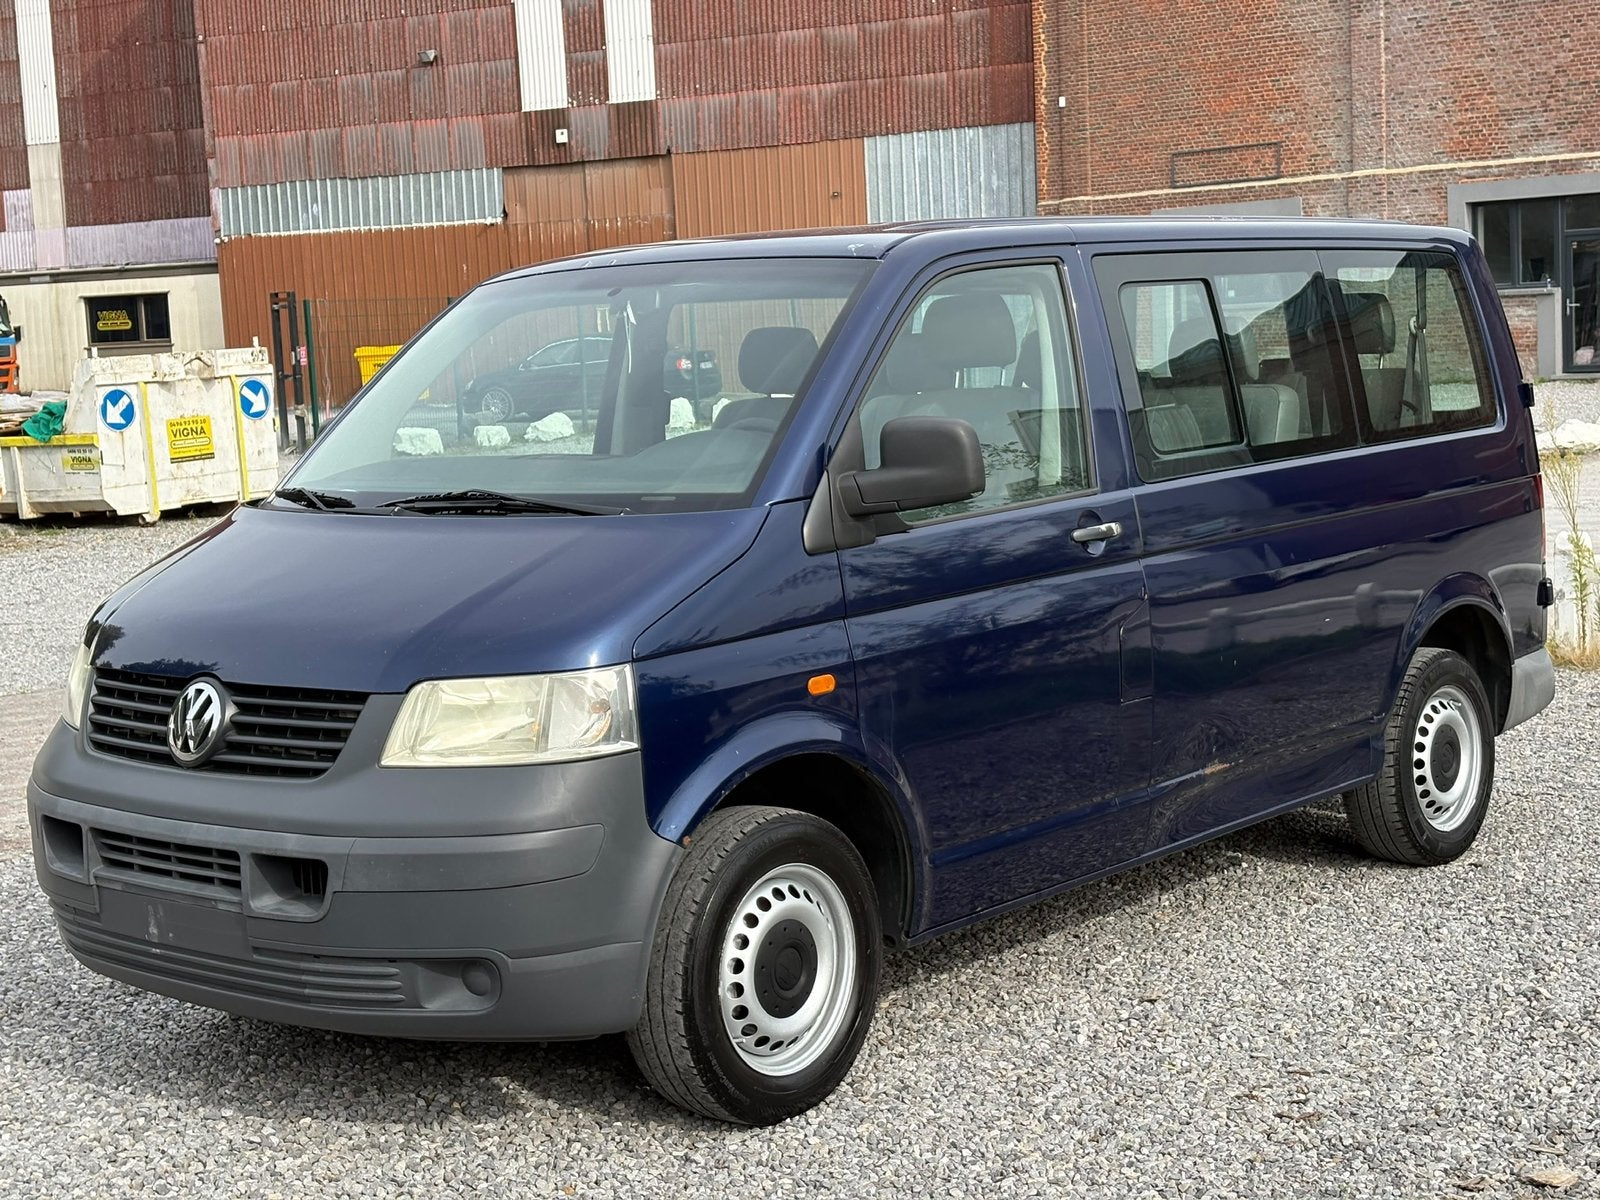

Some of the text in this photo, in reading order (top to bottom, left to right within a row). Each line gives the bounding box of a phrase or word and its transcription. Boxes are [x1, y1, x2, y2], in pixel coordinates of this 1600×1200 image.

[97, 310, 128, 320] VIGNA
[171, 426, 206, 438] VIGNA
[170, 682, 221, 761] VW
